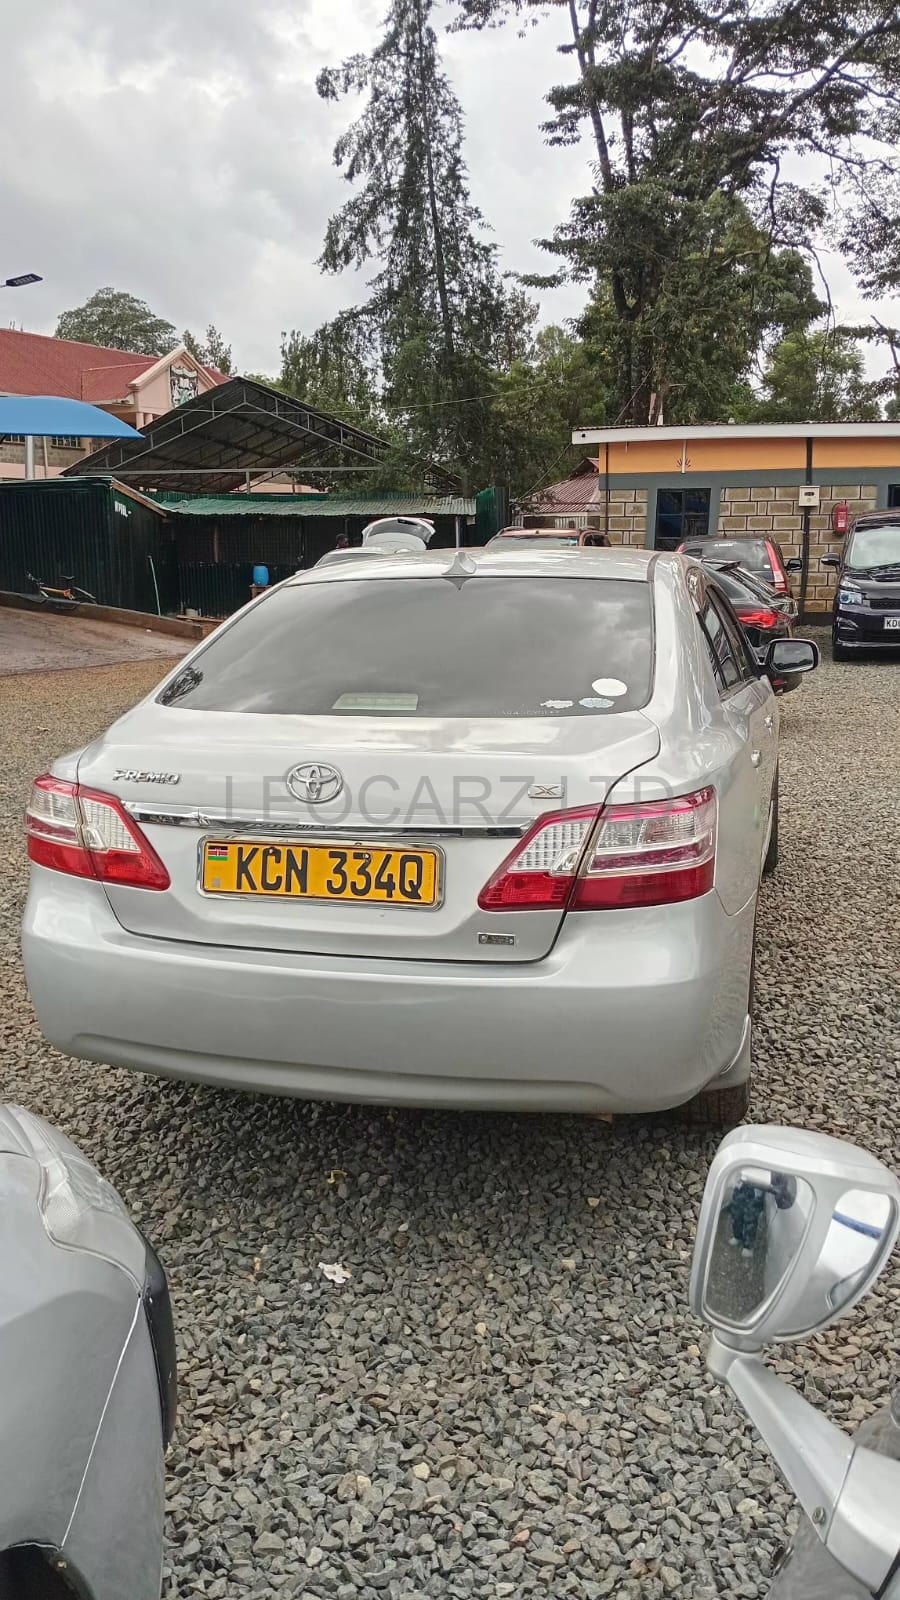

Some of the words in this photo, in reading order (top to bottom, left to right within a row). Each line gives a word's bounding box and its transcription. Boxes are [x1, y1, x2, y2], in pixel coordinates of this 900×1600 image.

[112, 769, 180, 785] PREMIO
[236, 846, 308, 893] KCN
[326, 850, 423, 900] 334Q
